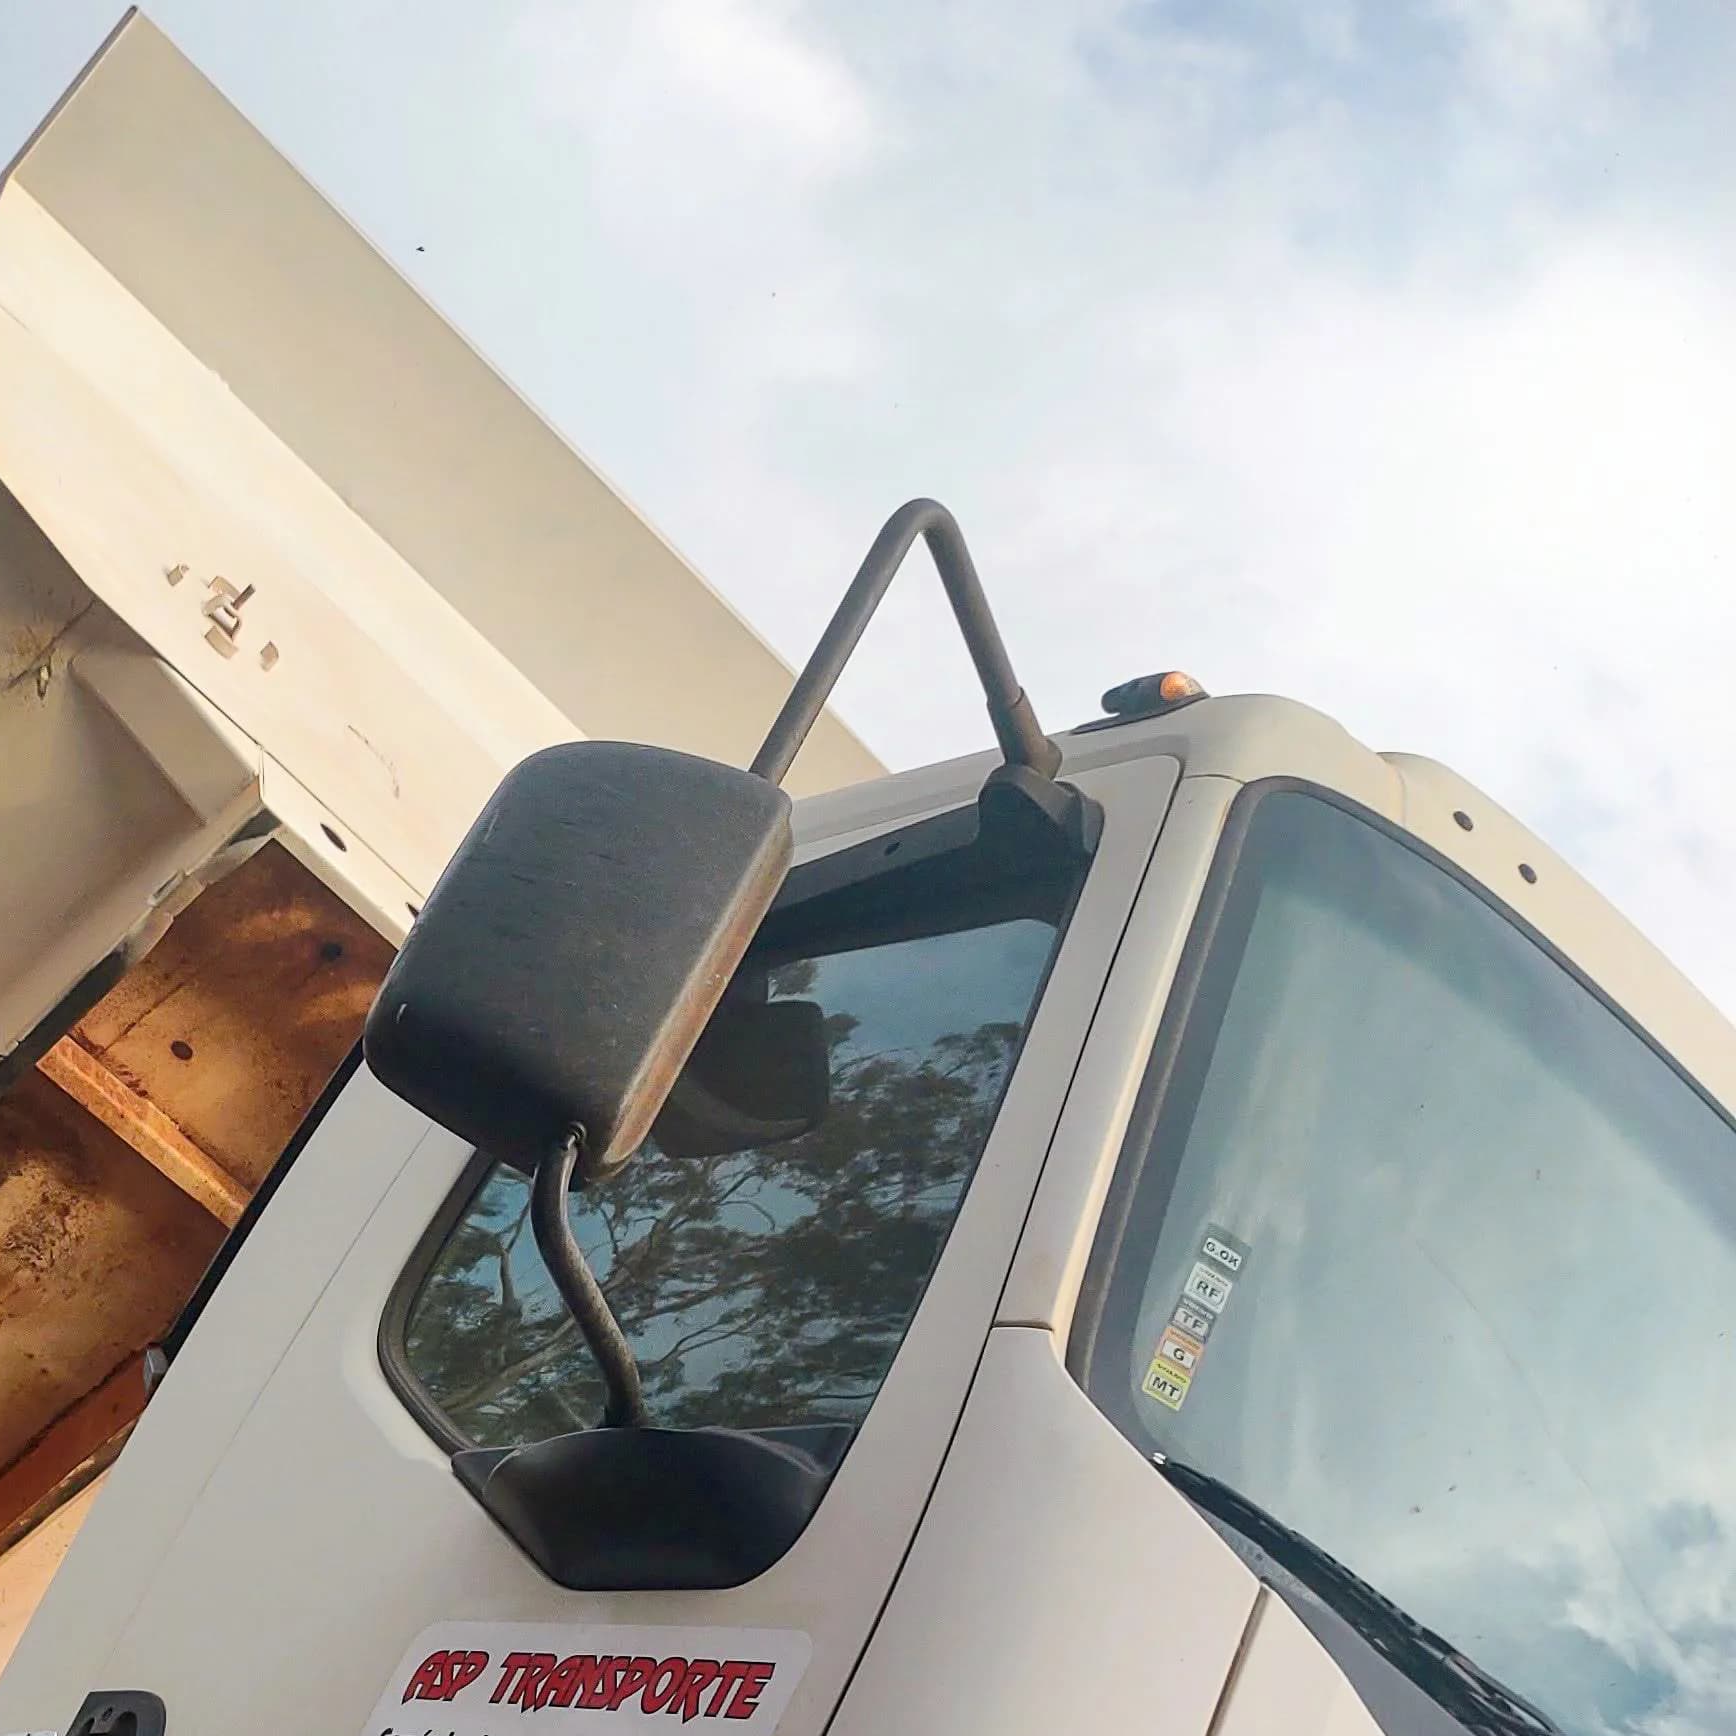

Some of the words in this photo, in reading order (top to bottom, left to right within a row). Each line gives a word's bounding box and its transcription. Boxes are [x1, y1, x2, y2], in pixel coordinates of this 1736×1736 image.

[1196, 1279, 1223, 1300] RF
[1182, 1310, 1204, 1331] TF
[1173, 1347, 1185, 1362] G
[1152, 1376, 1180, 1398] MT
[402, 1650, 490, 1704] ASP
[488, 1652, 776, 1724] TRANSPORTE
